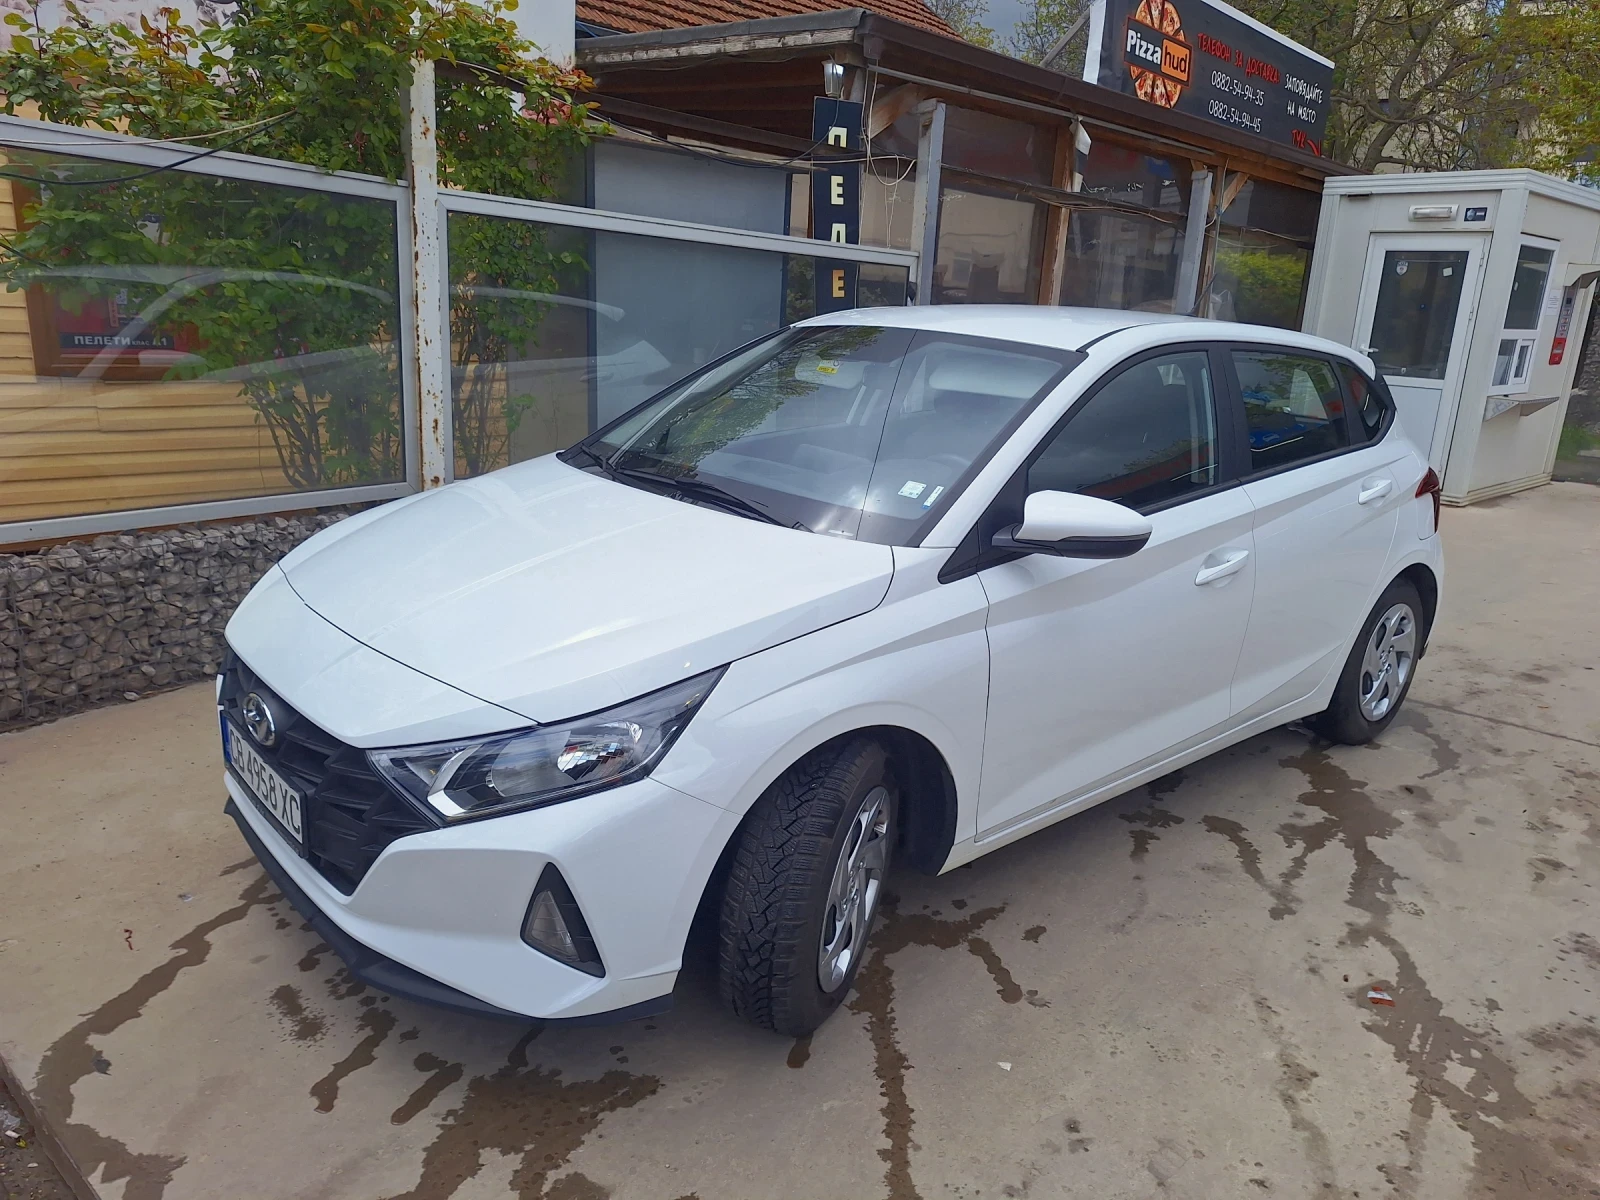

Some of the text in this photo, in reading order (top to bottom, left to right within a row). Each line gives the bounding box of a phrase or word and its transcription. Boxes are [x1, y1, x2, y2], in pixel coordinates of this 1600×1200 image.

[1126, 29, 1188, 74] Pizza hud
[1197, 32, 1232, 62] ТЕЛЕФОН
[1234, 49, 1244, 68] ЗА
[1211, 70, 1265, 106] 0882-54-94-35
[1285, 73, 1324, 104] ЗАПОВЯДАЙТЕ
[1208, 99, 1262, 133] 0882-54-94-45
[1287, 100, 1317, 123] НА МЯСТО
[1291, 129, 1307, 149] ТУК
[73, 335, 131, 346] ПЕЛЕТИ
[229, 729, 245, 773] CB
[247, 750, 277, 811] 4958
[279, 782, 301, 836] XC
